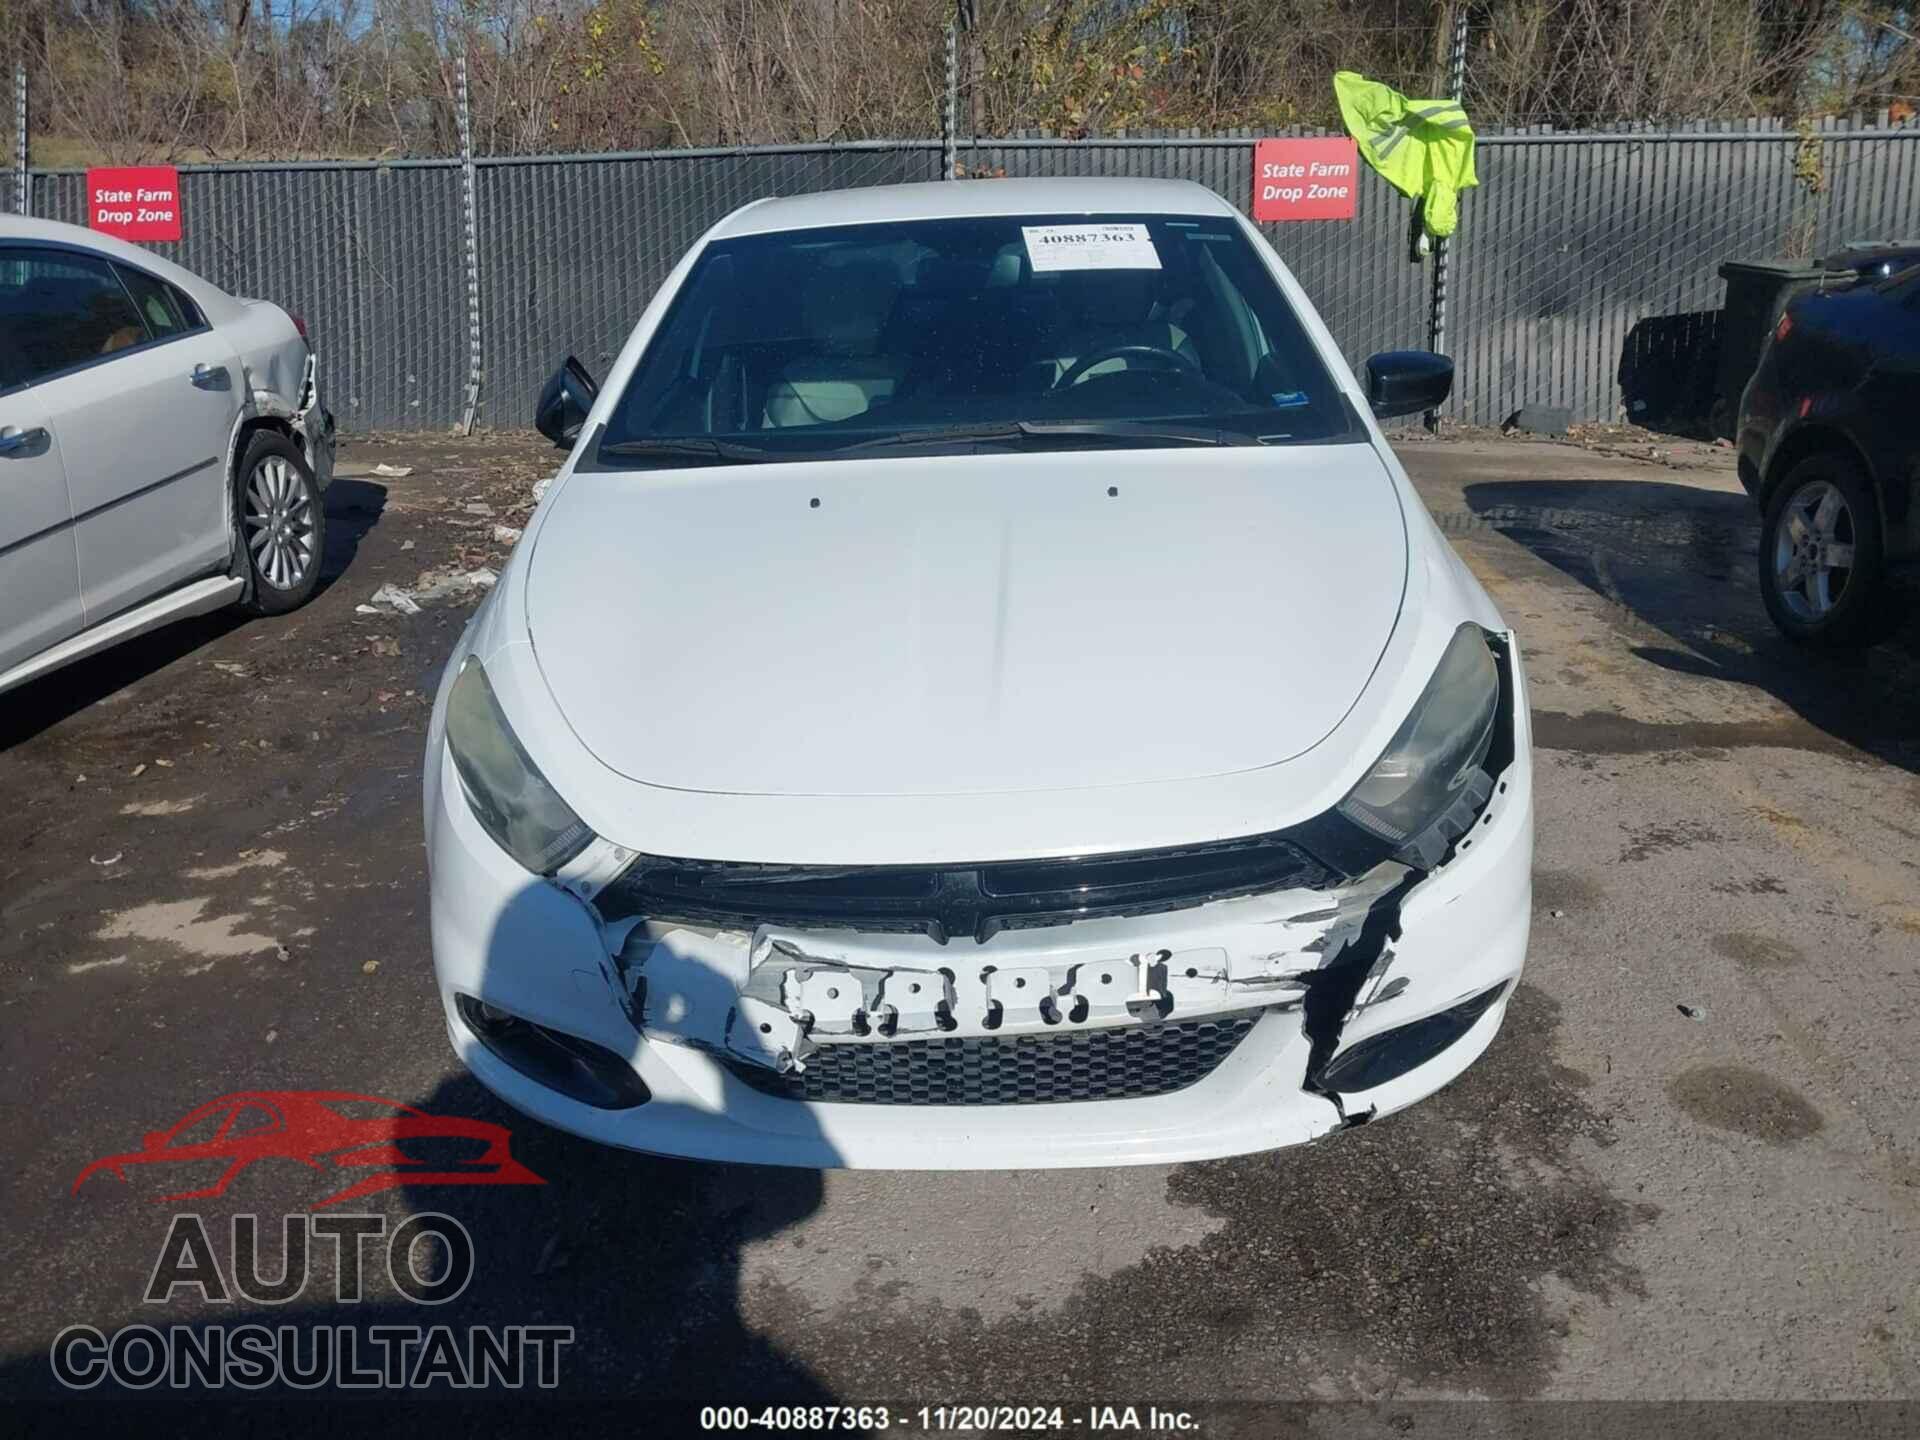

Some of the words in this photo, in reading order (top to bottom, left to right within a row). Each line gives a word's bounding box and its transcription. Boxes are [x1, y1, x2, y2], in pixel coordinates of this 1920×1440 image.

[1262, 163, 1305, 178] State
[1309, 162, 1350, 176] Farm
[95, 189, 132, 203] State
[136, 188, 172, 202] Farm
[1263, 185, 1303, 202] Drop
[1307, 184, 1348, 199] Zone
[97, 209, 133, 225] Drop
[136, 208, 173, 222] Zone
[1039, 232, 1135, 244] 40887363
